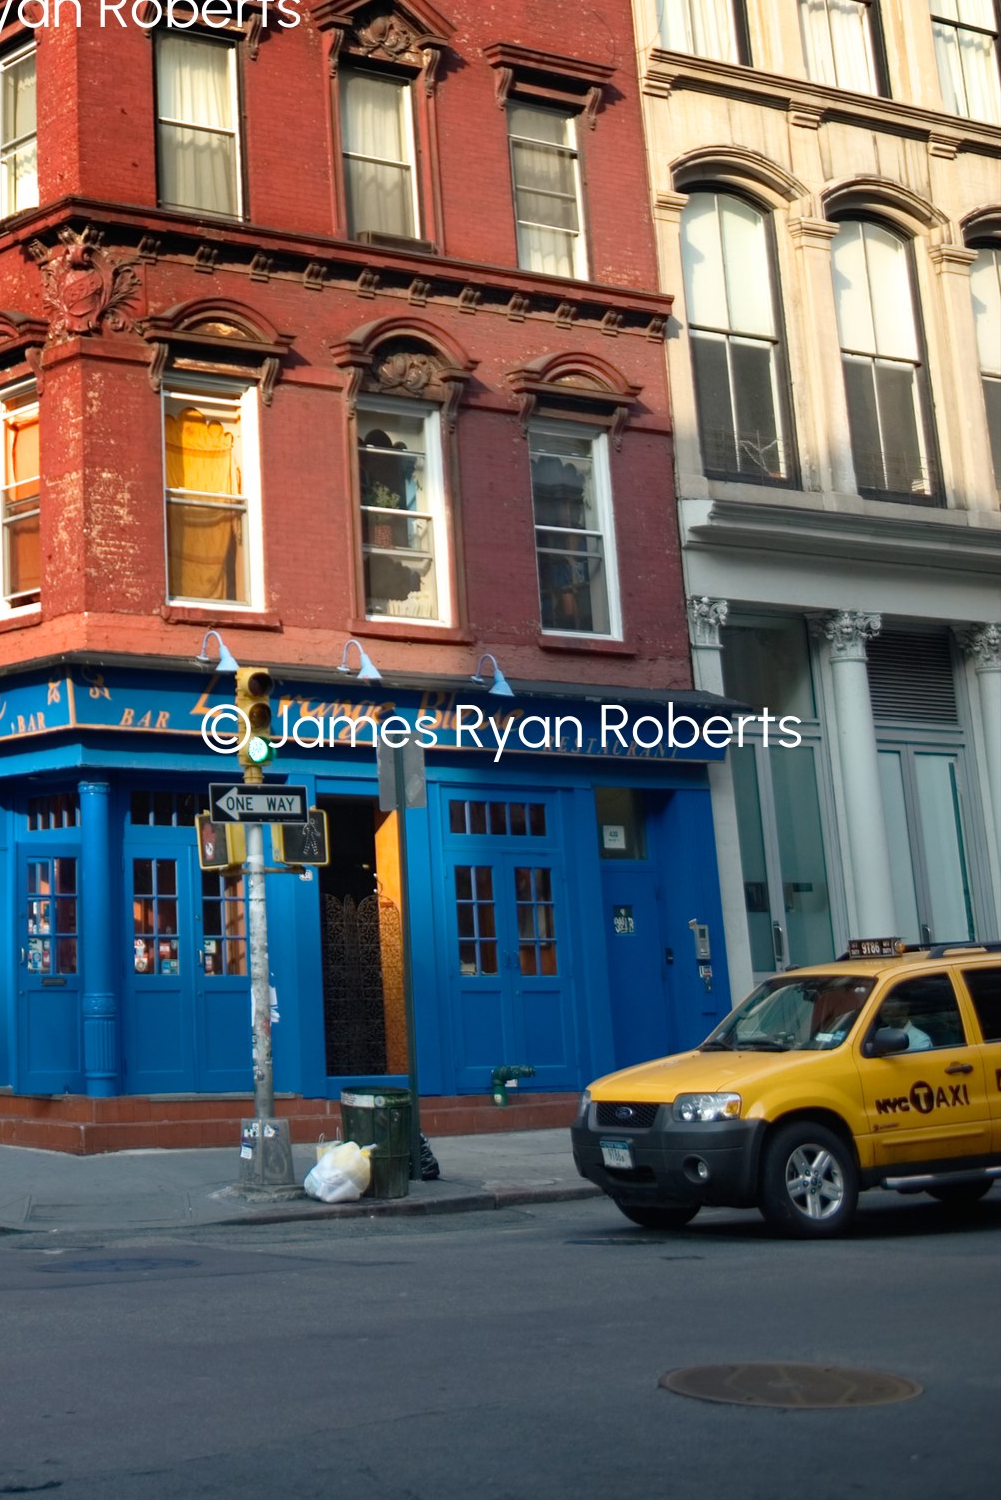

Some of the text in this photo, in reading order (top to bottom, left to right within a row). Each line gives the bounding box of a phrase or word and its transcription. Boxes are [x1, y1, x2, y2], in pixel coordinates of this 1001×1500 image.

[17, 712, 47, 735] BAR
[120, 709, 170, 728] BAR
[226, 796, 295, 812] ONE WAY
[861, 941, 880, 954] 9T86
[875, 1081, 970, 1115] NYC TAXI
